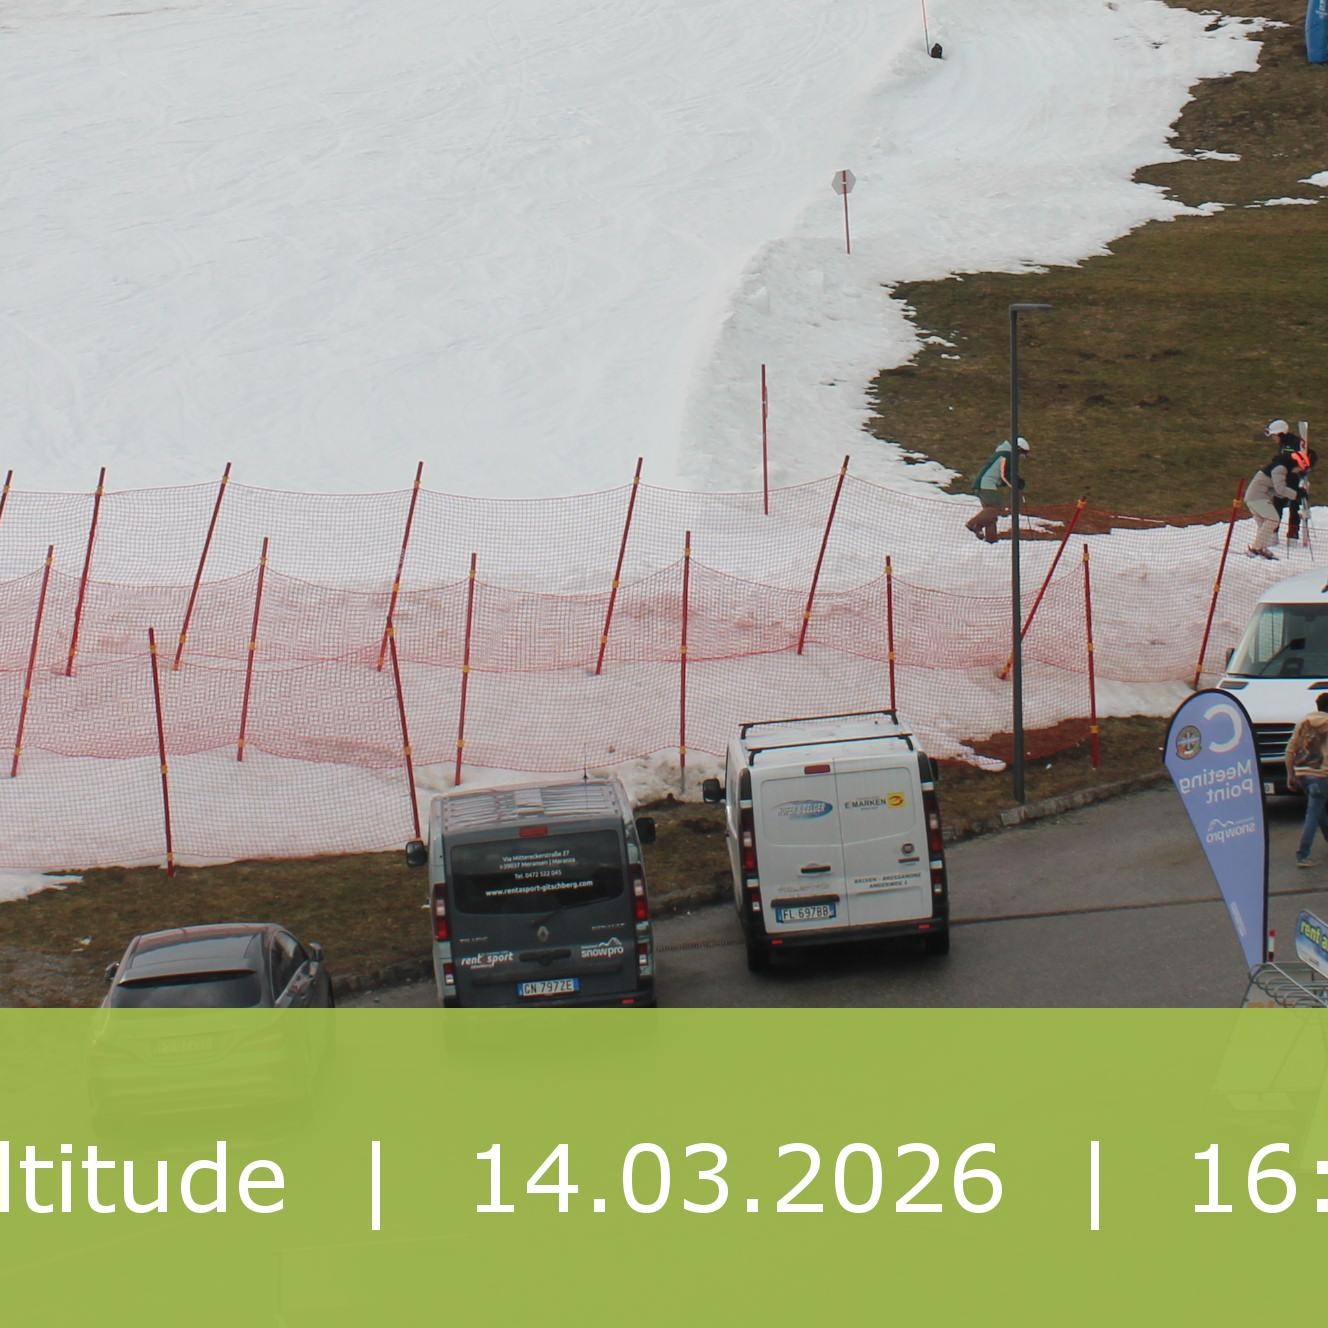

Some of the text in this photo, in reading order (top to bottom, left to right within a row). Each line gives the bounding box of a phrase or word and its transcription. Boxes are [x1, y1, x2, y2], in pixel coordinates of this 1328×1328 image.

[485, 879, 594, 897] www.rentasport-gitschberg.com
[1300, 921, 1321, 945] rent
[581, 944, 624, 959] snowpro
